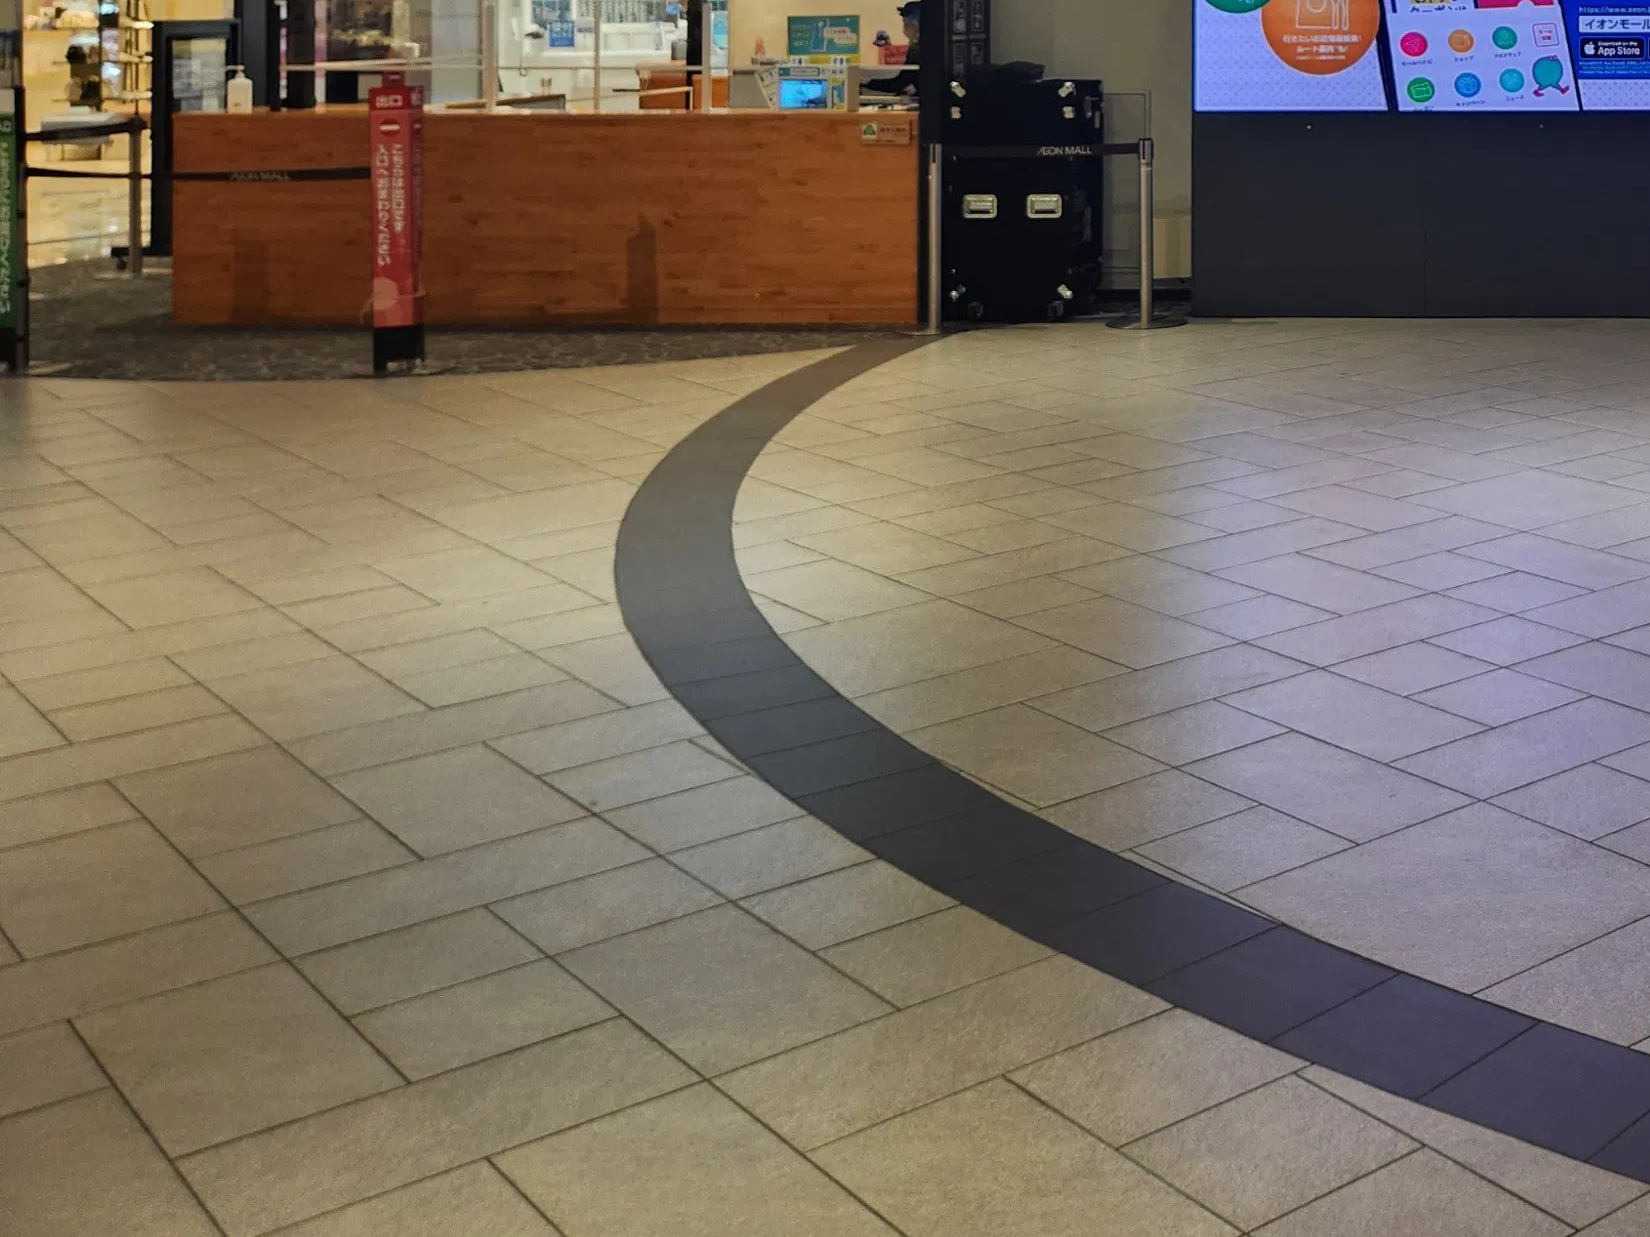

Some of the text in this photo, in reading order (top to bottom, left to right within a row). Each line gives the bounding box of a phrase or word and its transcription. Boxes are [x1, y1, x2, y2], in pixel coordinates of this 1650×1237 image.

[1598, 47, 1640, 56] App Store
[1065, 146, 1093, 155] MALL
